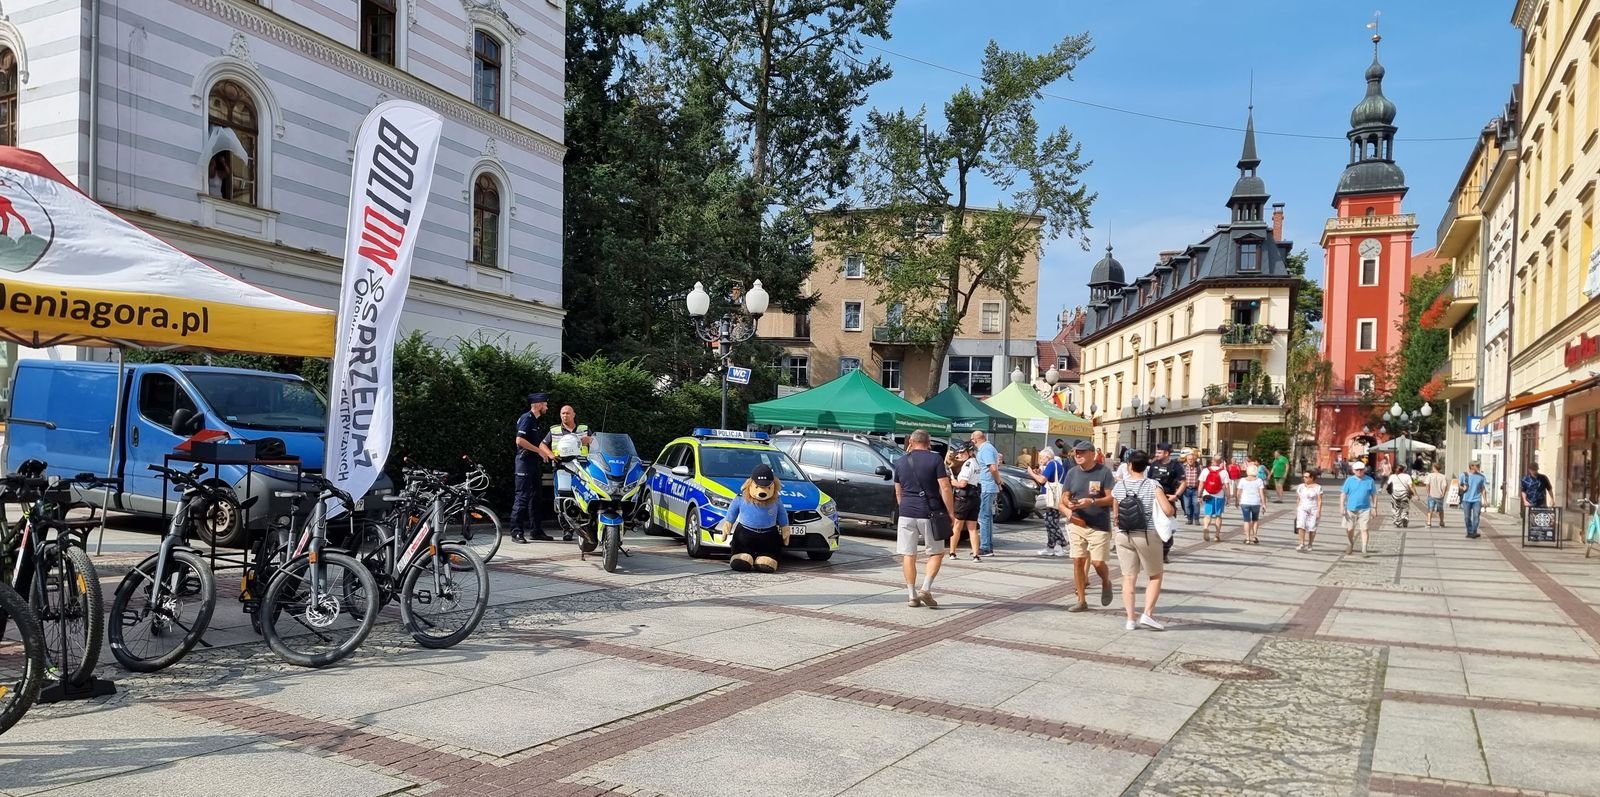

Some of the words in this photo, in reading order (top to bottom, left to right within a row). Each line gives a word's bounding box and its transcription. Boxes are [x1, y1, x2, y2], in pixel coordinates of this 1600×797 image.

[732, 368, 747, 378] WC
[717, 430, 743, 438] POLICJA
[778, 490, 807, 498] ICJA
